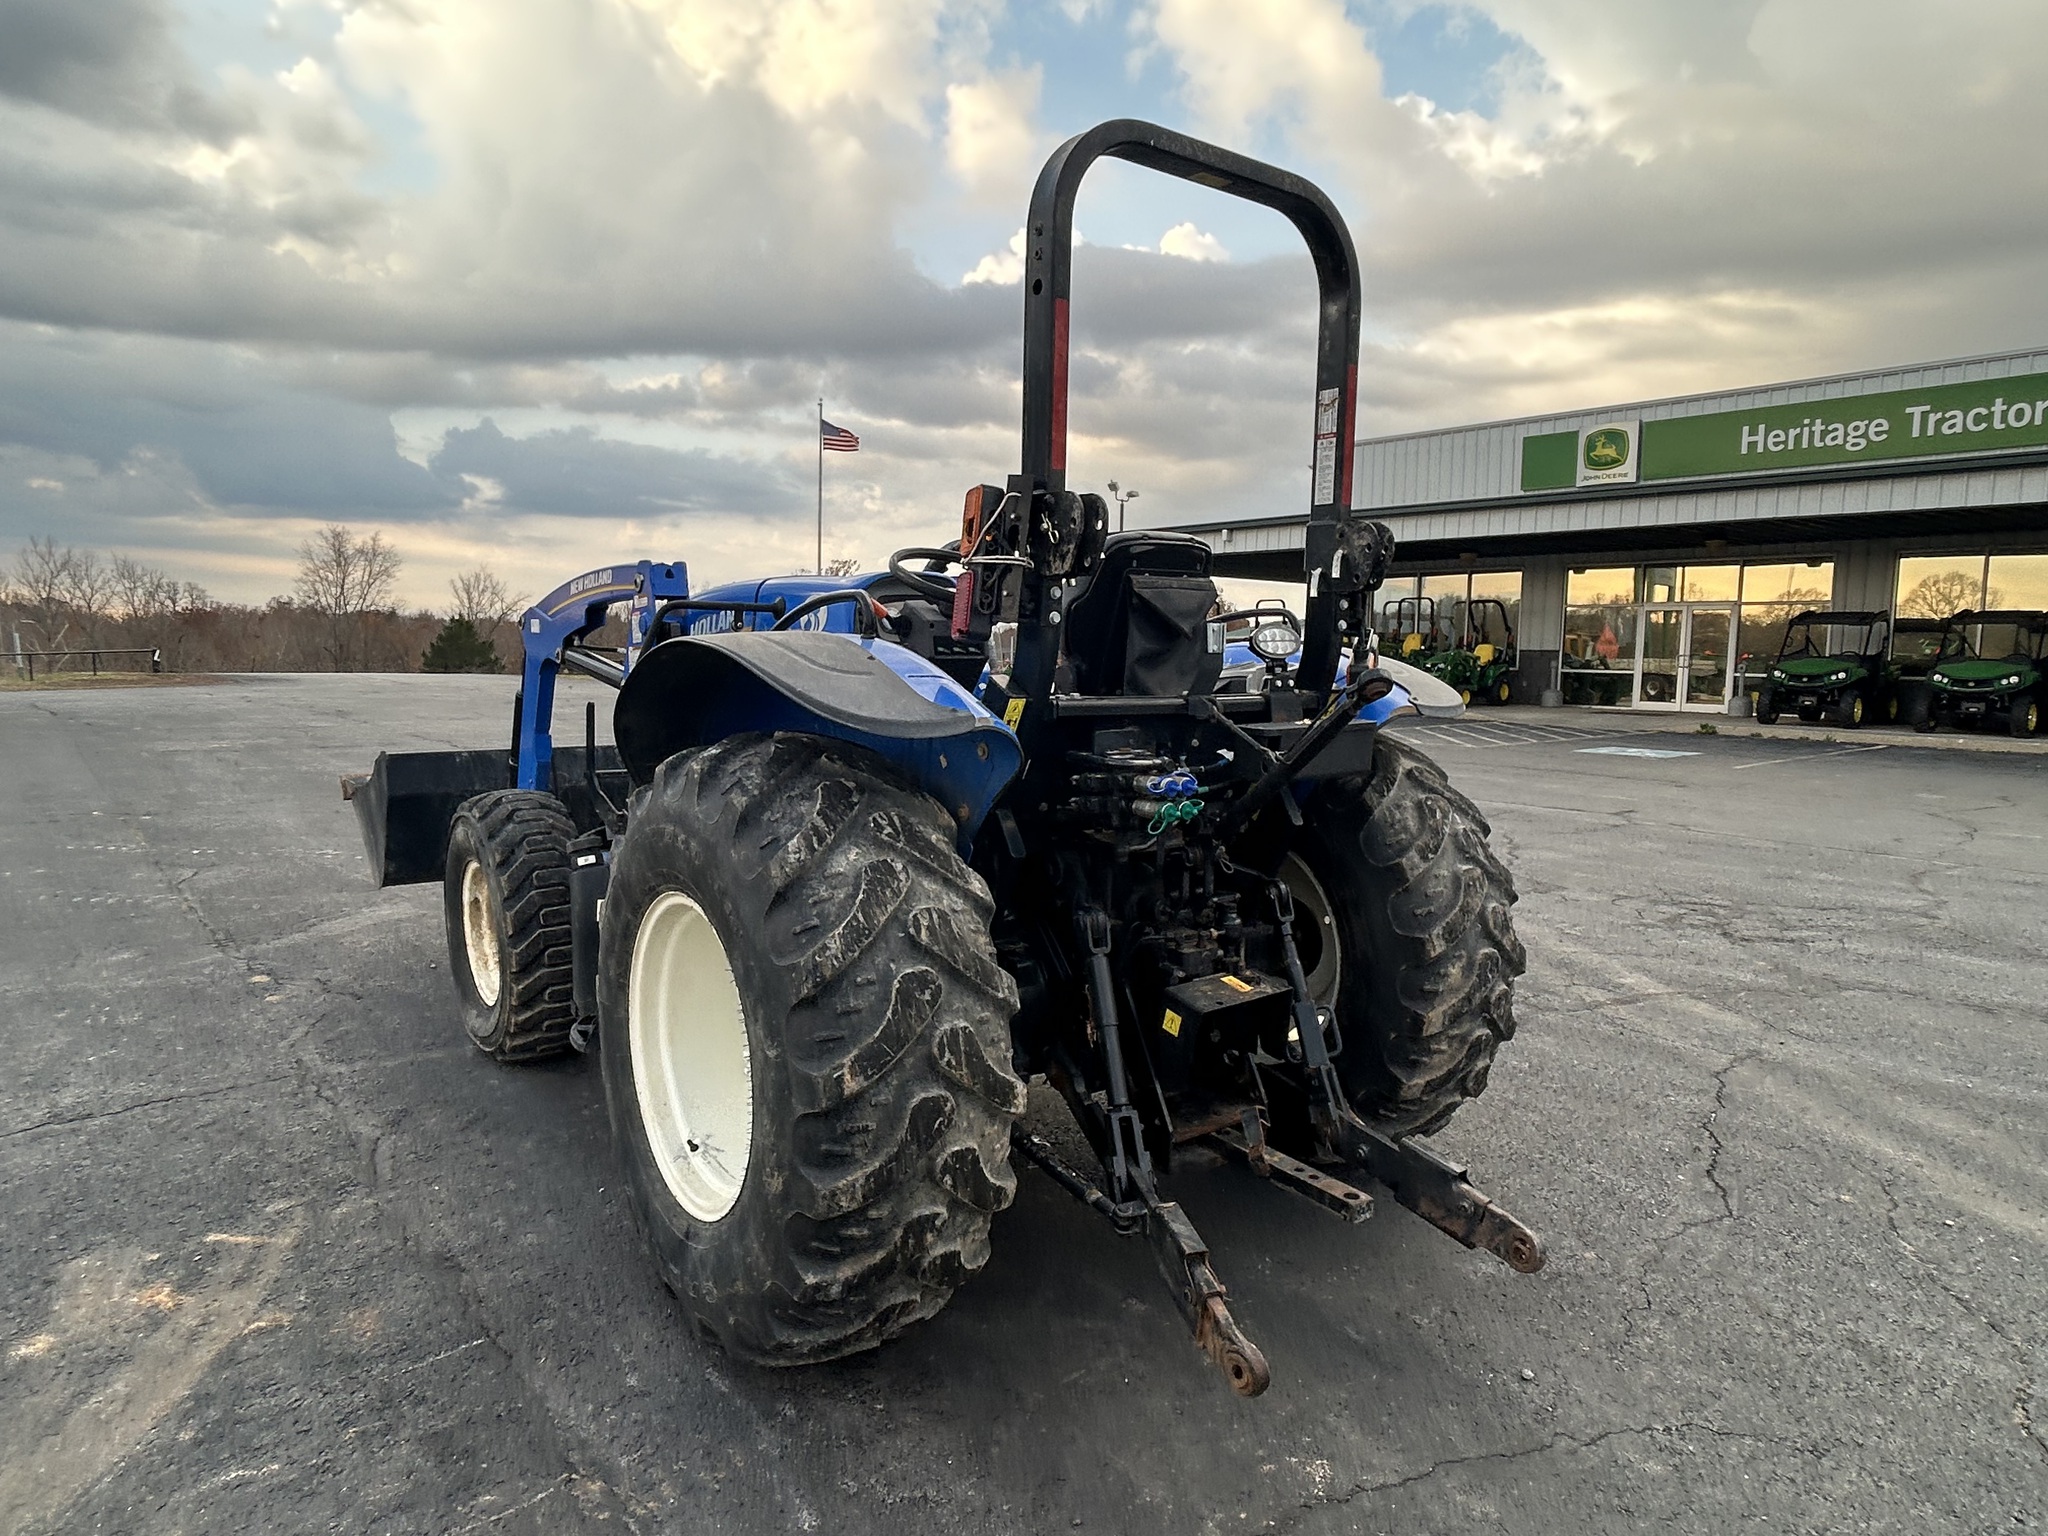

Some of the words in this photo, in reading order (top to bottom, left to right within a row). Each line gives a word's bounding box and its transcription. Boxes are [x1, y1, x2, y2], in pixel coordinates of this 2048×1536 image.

[1740, 418, 1890, 454] Heritage
[1905, 398, 2048, 438] Tractor
[1581, 474, 1600, 482] JOHN
[1601, 472, 1629, 480] DEERE
[569, 578, 584, 595] NEW
[584, 569, 613, 590] HOLLAND
[690, 609, 746, 636] HOLLAN
